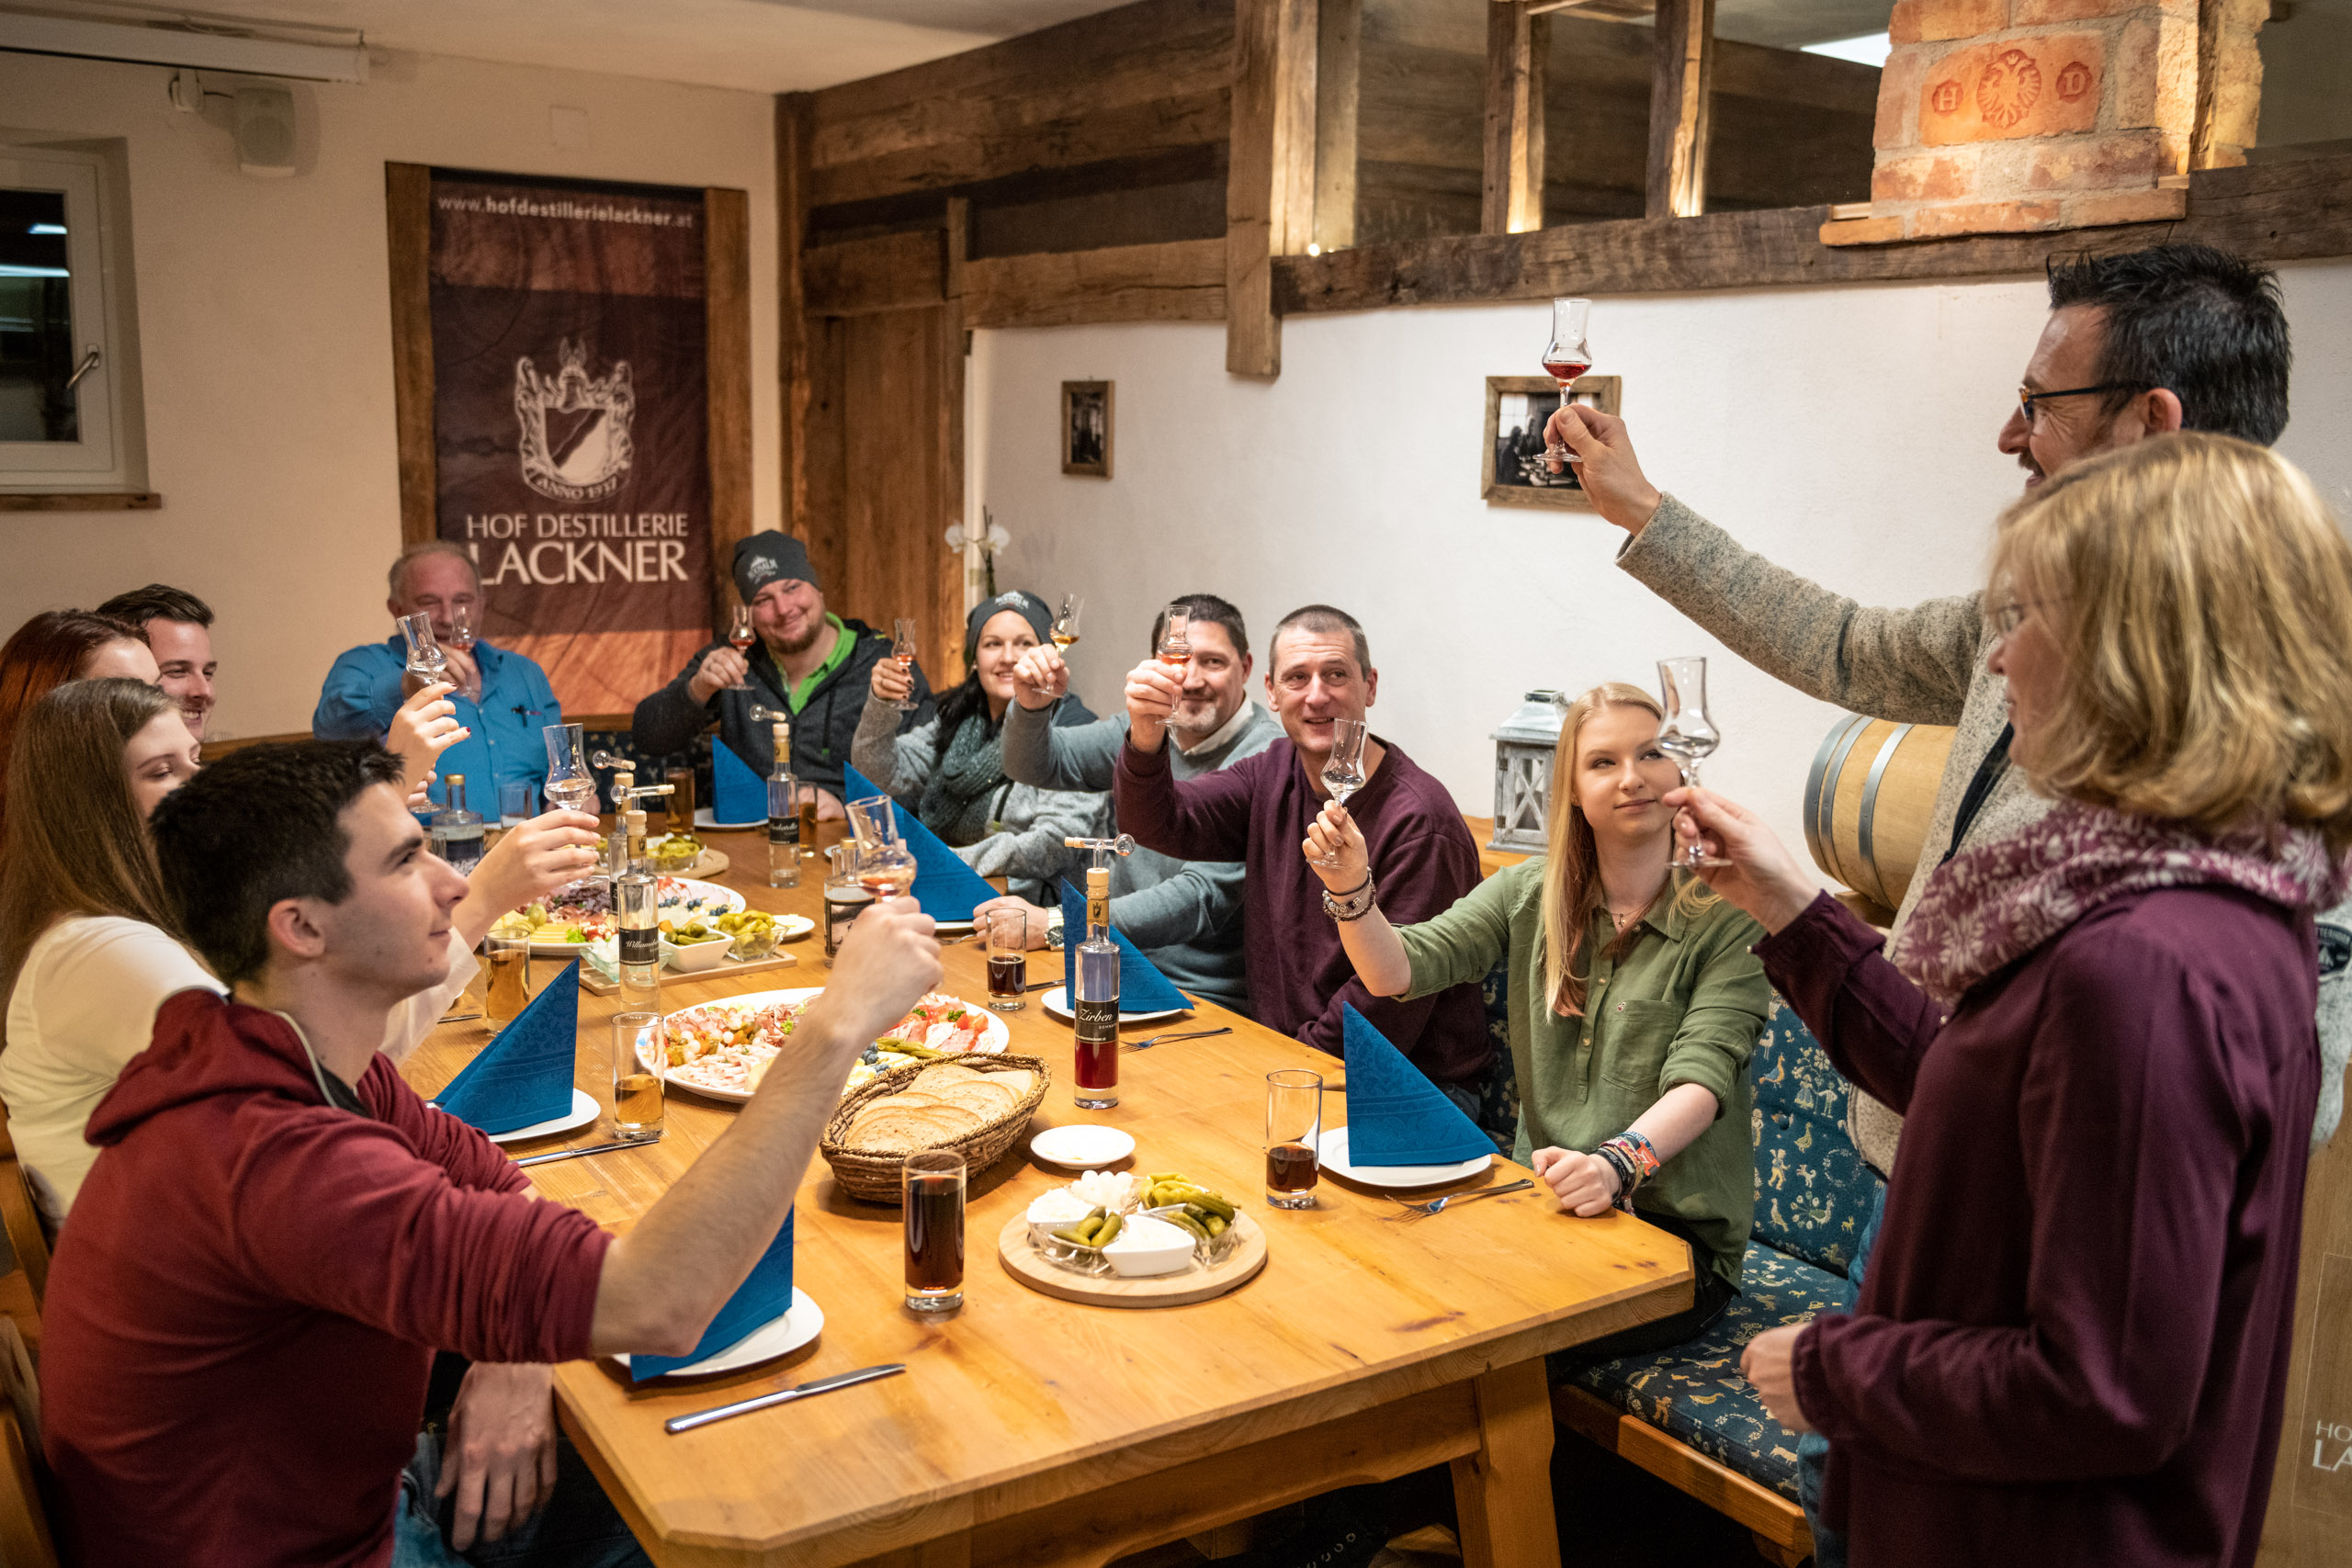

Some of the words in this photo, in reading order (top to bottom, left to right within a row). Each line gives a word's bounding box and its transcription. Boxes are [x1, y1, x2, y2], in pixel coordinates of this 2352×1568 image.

[1938, 86, 1958, 111] H
[437, 195, 693, 228] www.hofdestillerielackner.at
[536, 476, 585, 500] ANNO
[467, 513, 528, 539] HOF
[537, 513, 688, 538] DESTILLERIE
[469, 540, 689, 586] LACKNER
[1079, 1009, 1114, 1022] Zirben
